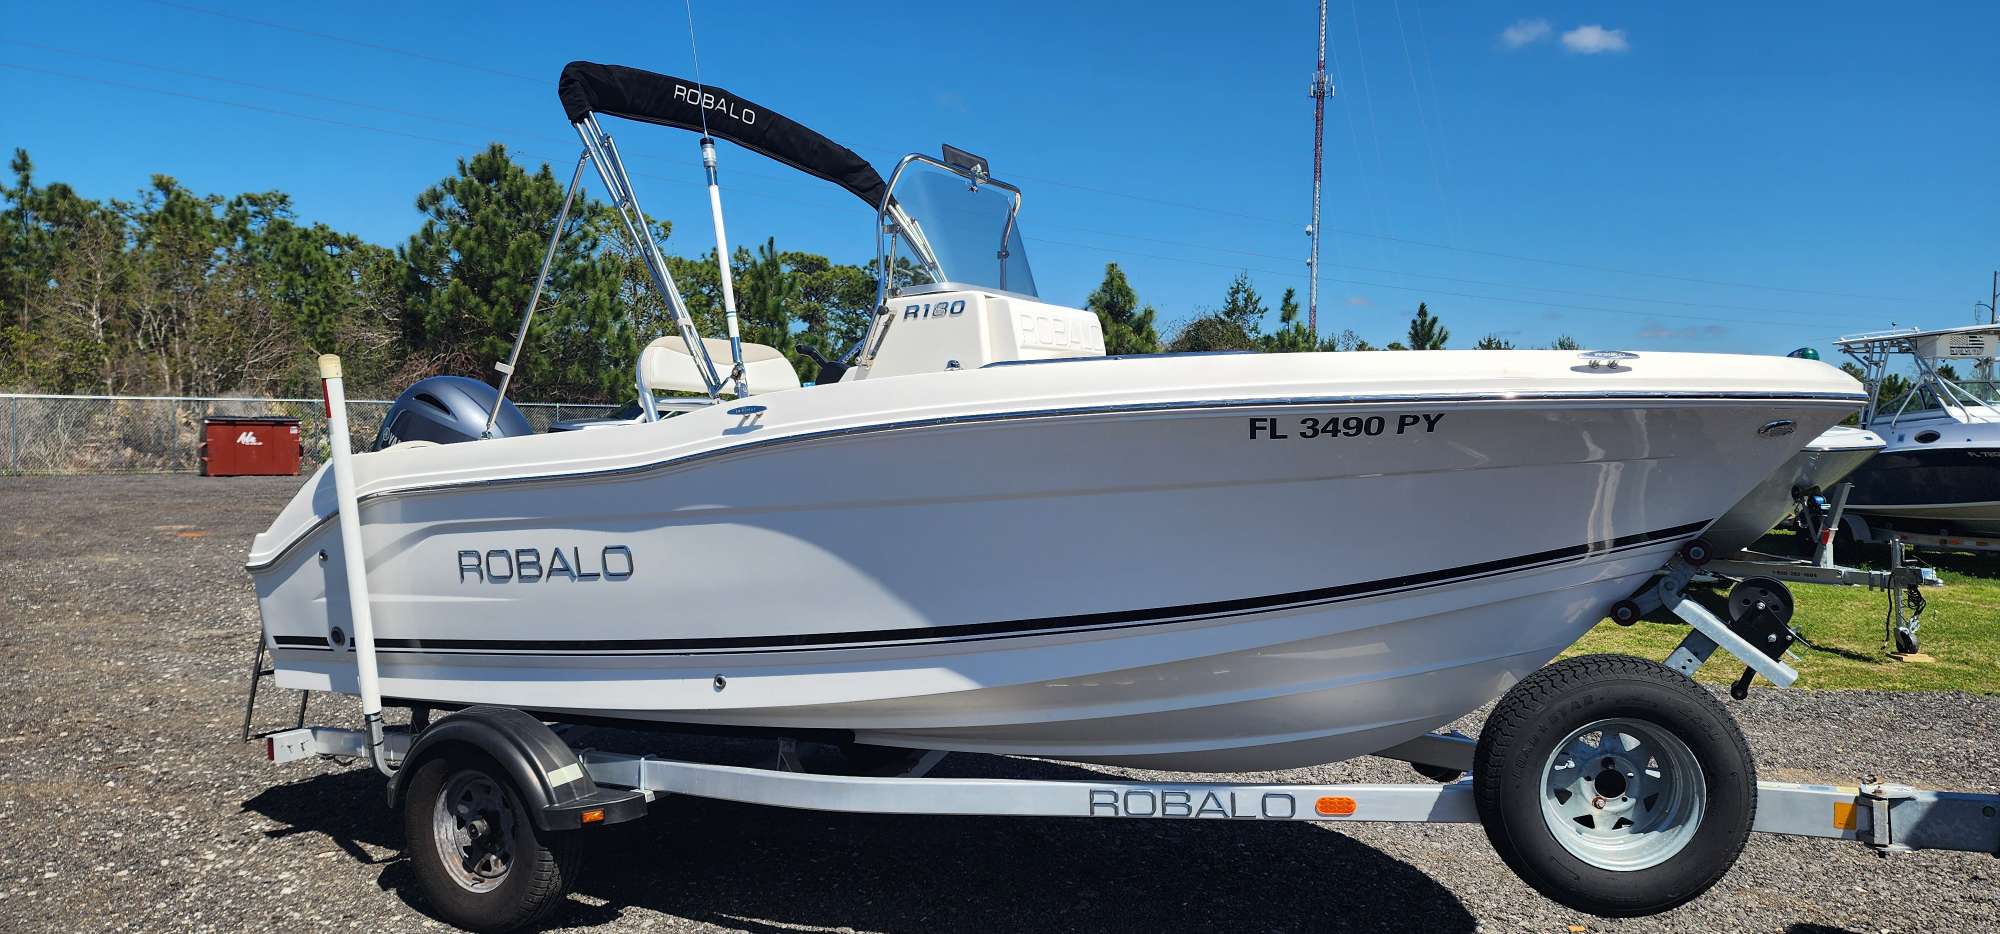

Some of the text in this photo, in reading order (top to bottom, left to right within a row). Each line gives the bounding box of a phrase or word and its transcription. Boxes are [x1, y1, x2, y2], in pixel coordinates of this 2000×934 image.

[673, 84, 756, 125] ROBALO
[903, 300, 966, 321] R180
[1249, 413, 1445, 439] FL 3490 PY
[457, 545, 634, 584] ROBALO
[1089, 788, 1296, 819] ROBALO
